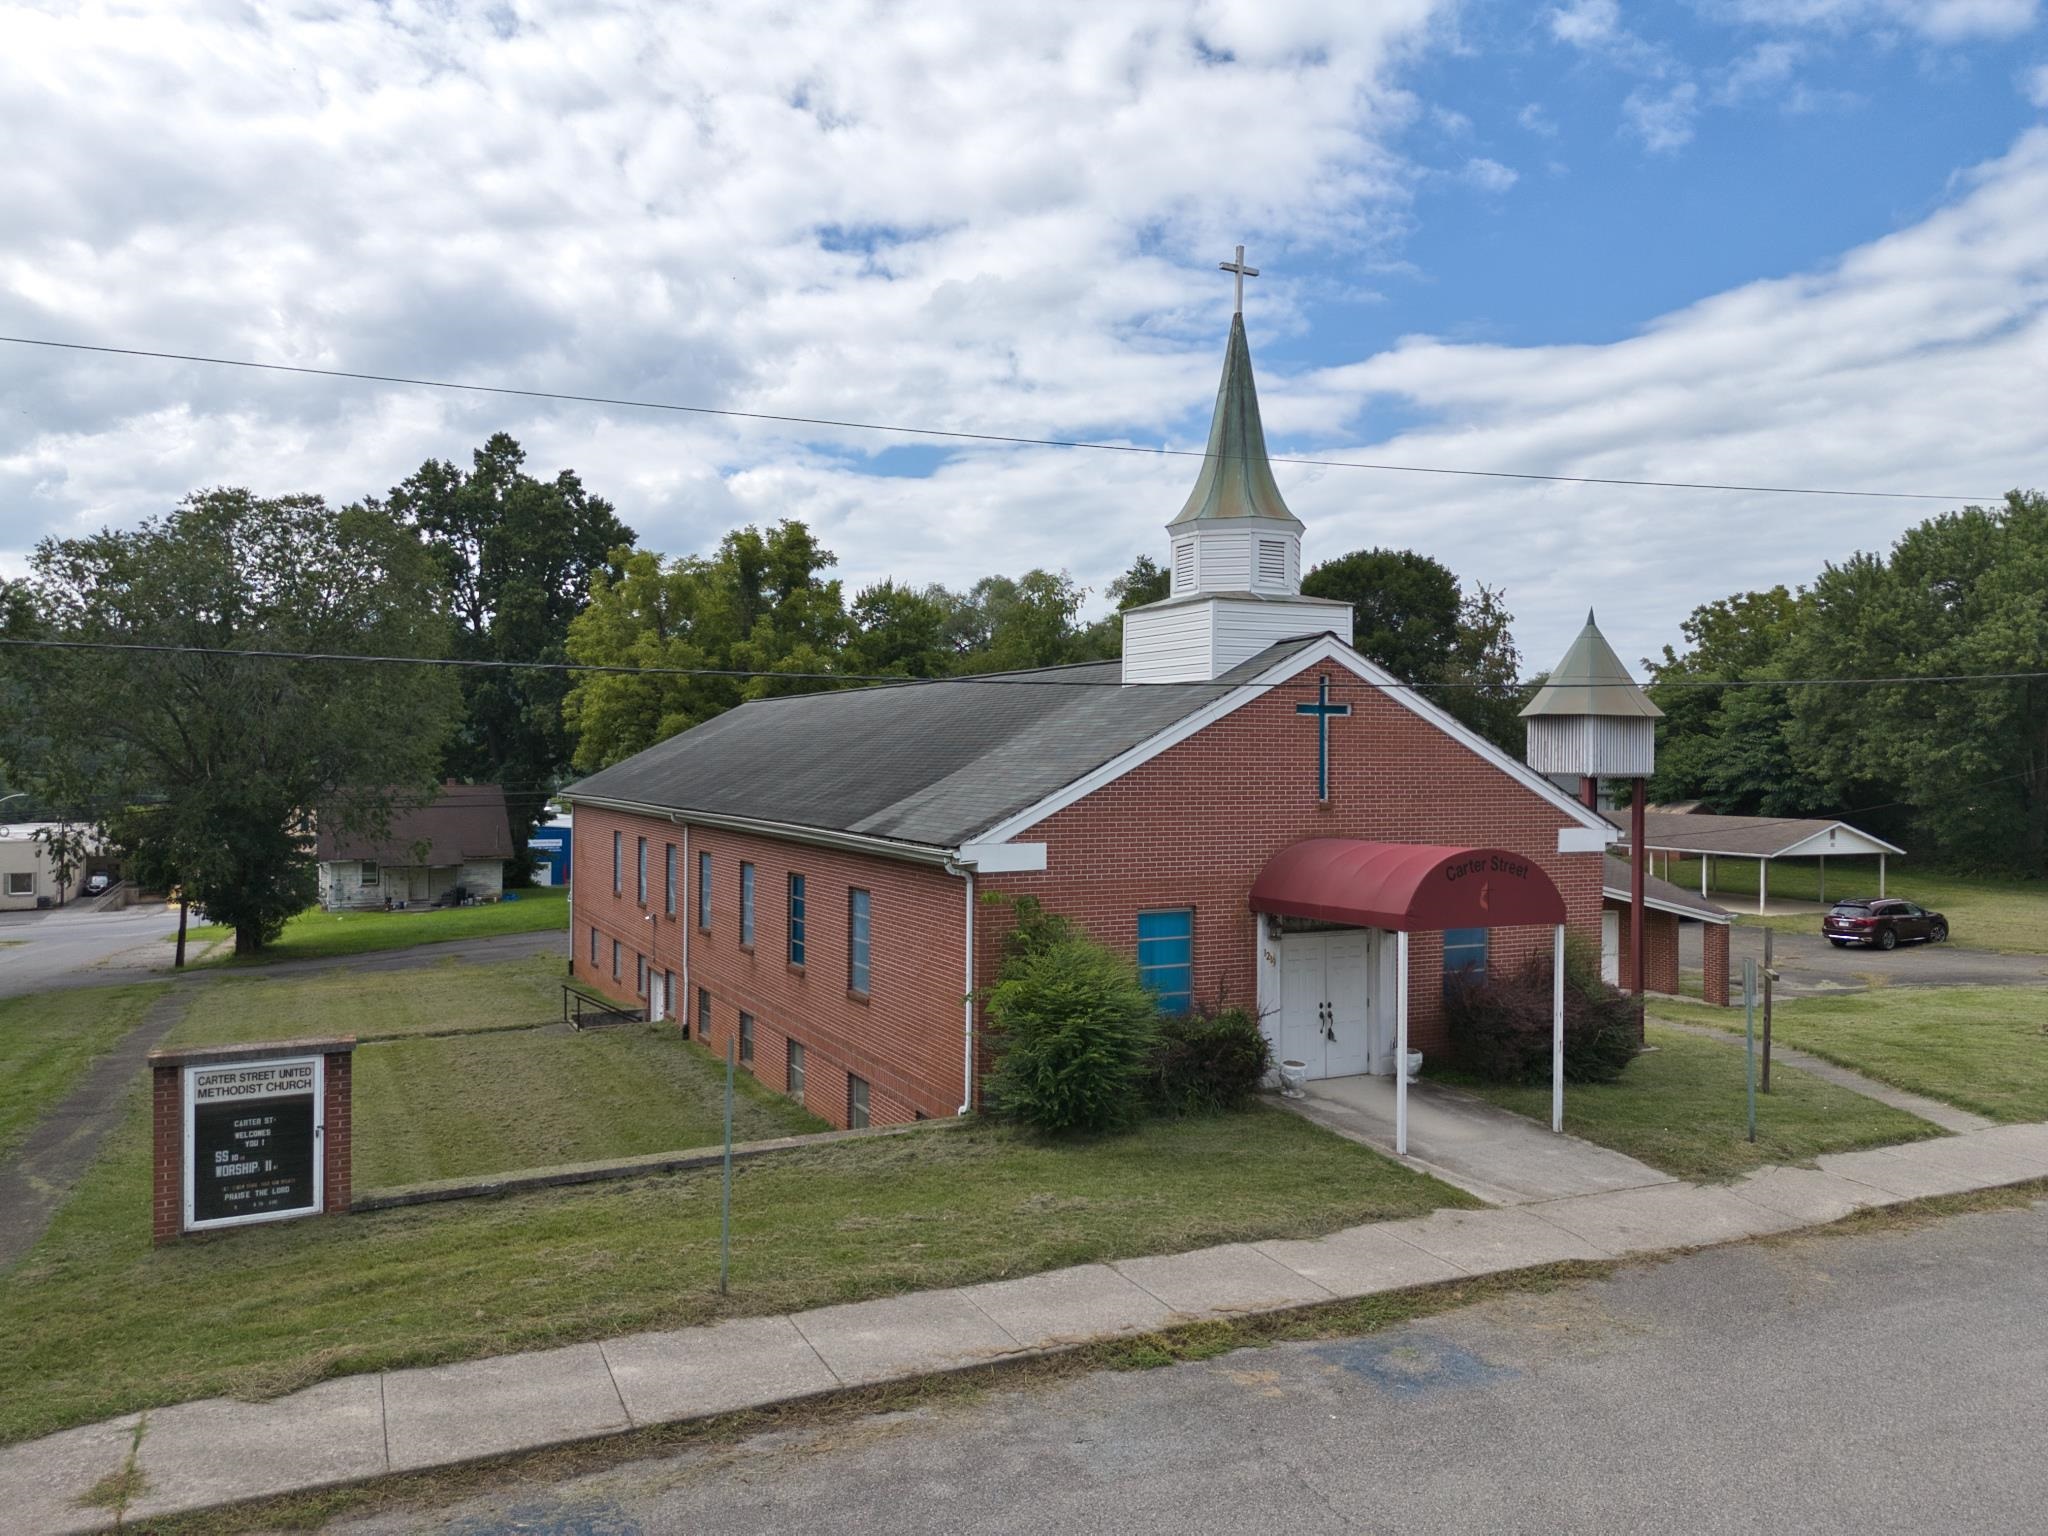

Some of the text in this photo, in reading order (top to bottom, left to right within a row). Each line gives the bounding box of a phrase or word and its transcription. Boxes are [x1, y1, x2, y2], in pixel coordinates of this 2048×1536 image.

[1446, 856, 1529, 881] Carter Street
[198, 1067, 312, 1086] CARTER STREET UNITED
[197, 1079, 312, 1099] METHODIST CHURCH
[234, 1118, 262, 1127] CARTER
[234, 1129, 272, 1139] WELCOMES
[215, 1150, 229, 1163] SS
[215, 1161, 259, 1178] WORSHIP
[224, 1186, 290, 1201] PRAISE THE LORD
